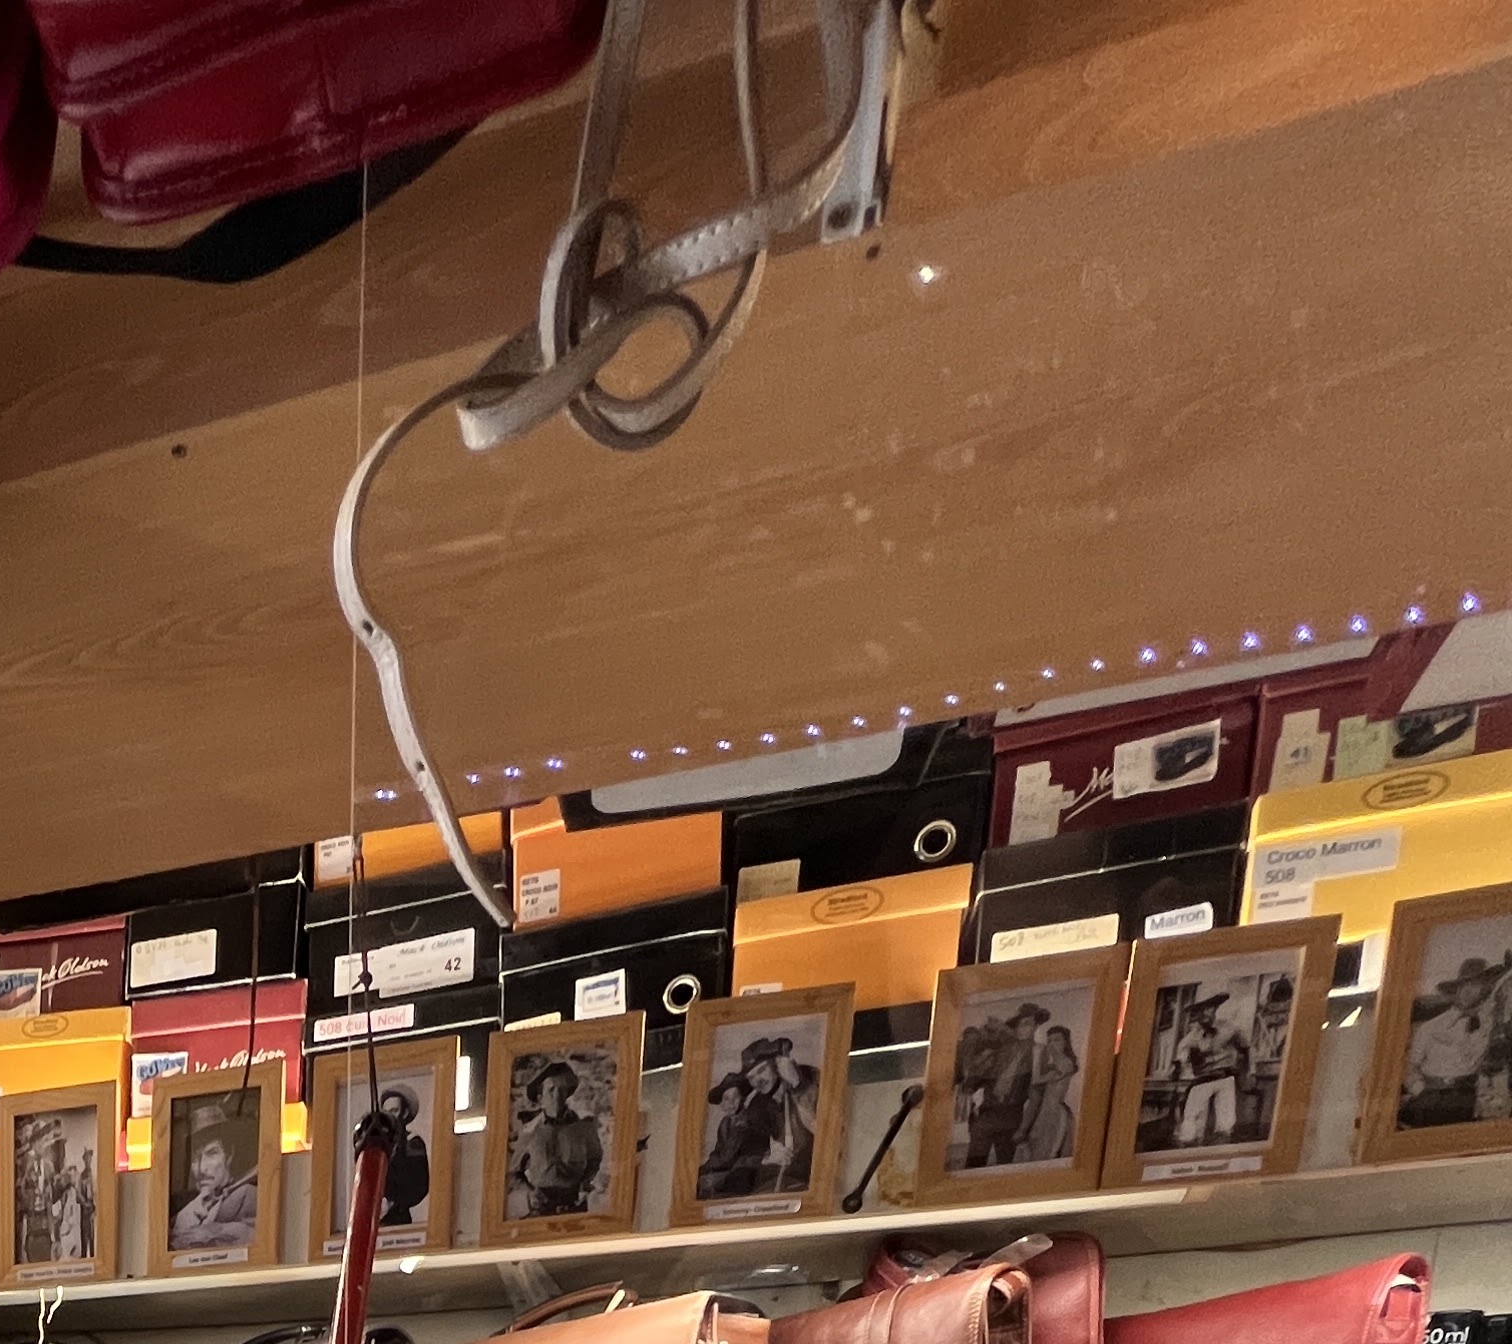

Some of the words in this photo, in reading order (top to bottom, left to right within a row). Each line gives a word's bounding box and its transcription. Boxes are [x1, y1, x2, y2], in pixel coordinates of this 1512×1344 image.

[1267, 845, 1317, 866] Croco
[1320, 836, 1383, 858] Marron
[1150, 908, 1207, 933] Marron
[443, 957, 463, 972] 42
[318, 1019, 342, 1036] 508
